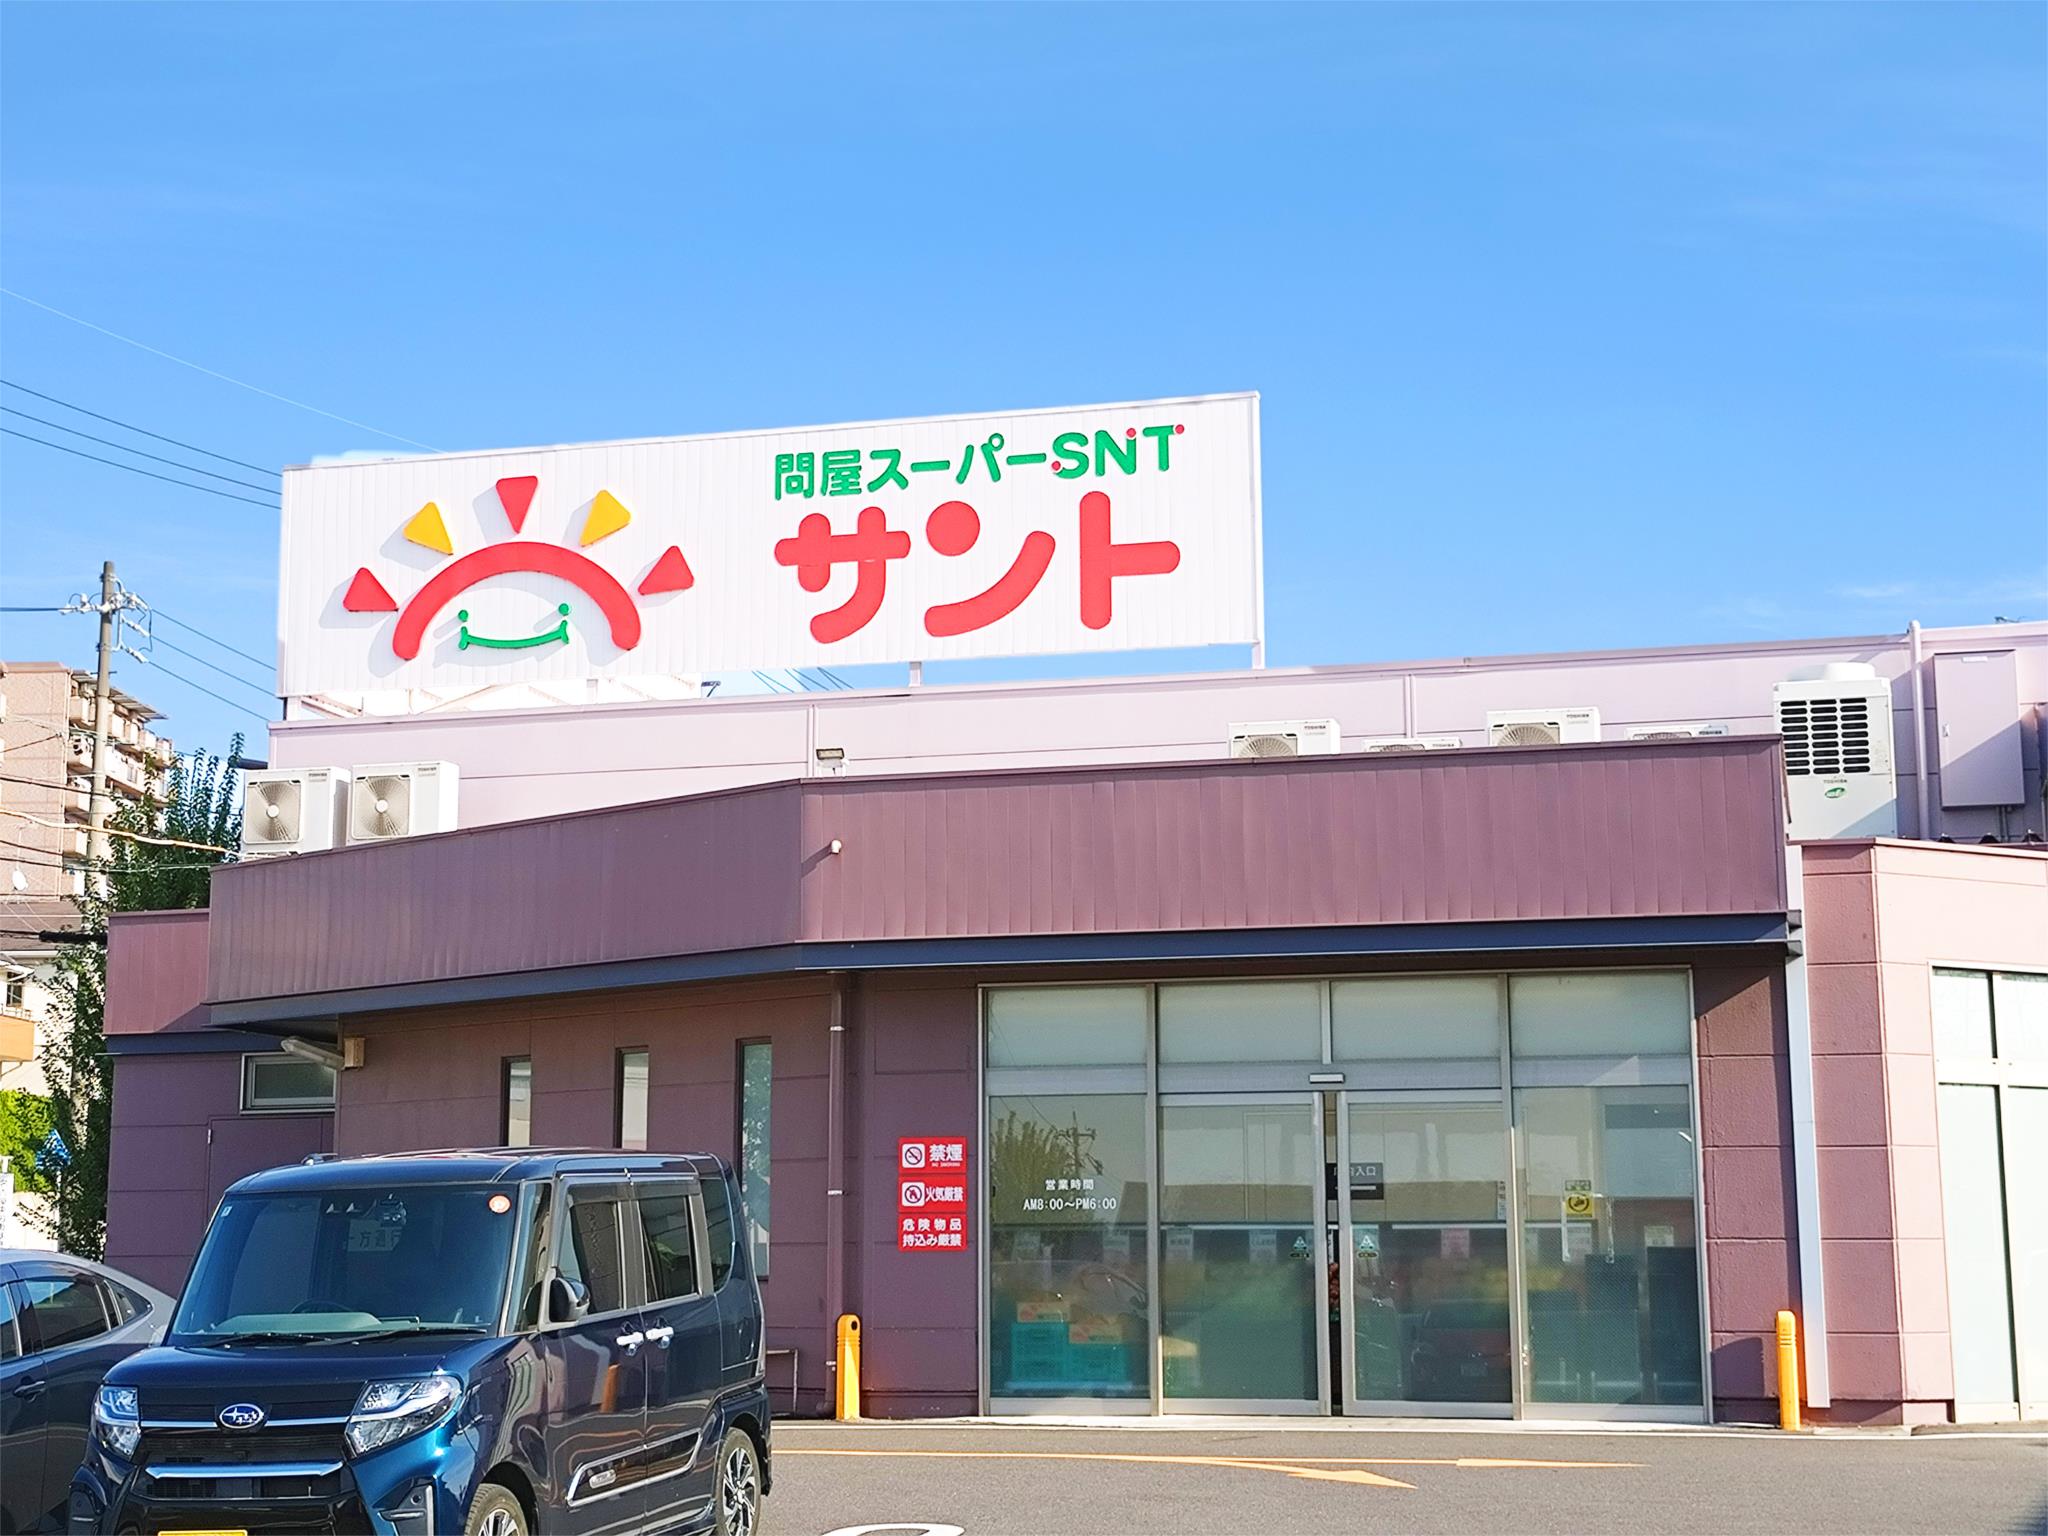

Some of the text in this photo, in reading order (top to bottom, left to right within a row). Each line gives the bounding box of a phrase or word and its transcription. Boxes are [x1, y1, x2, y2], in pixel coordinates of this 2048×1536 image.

[774, 491, 1181, 644] サント
[929, 1144, 963, 1161] 禁煙
[1045, 1179, 1094, 1191] 営業時間
[903, 1218, 962, 1231] 危険物品
[903, 1234, 962, 1247] 持込み厳禁
